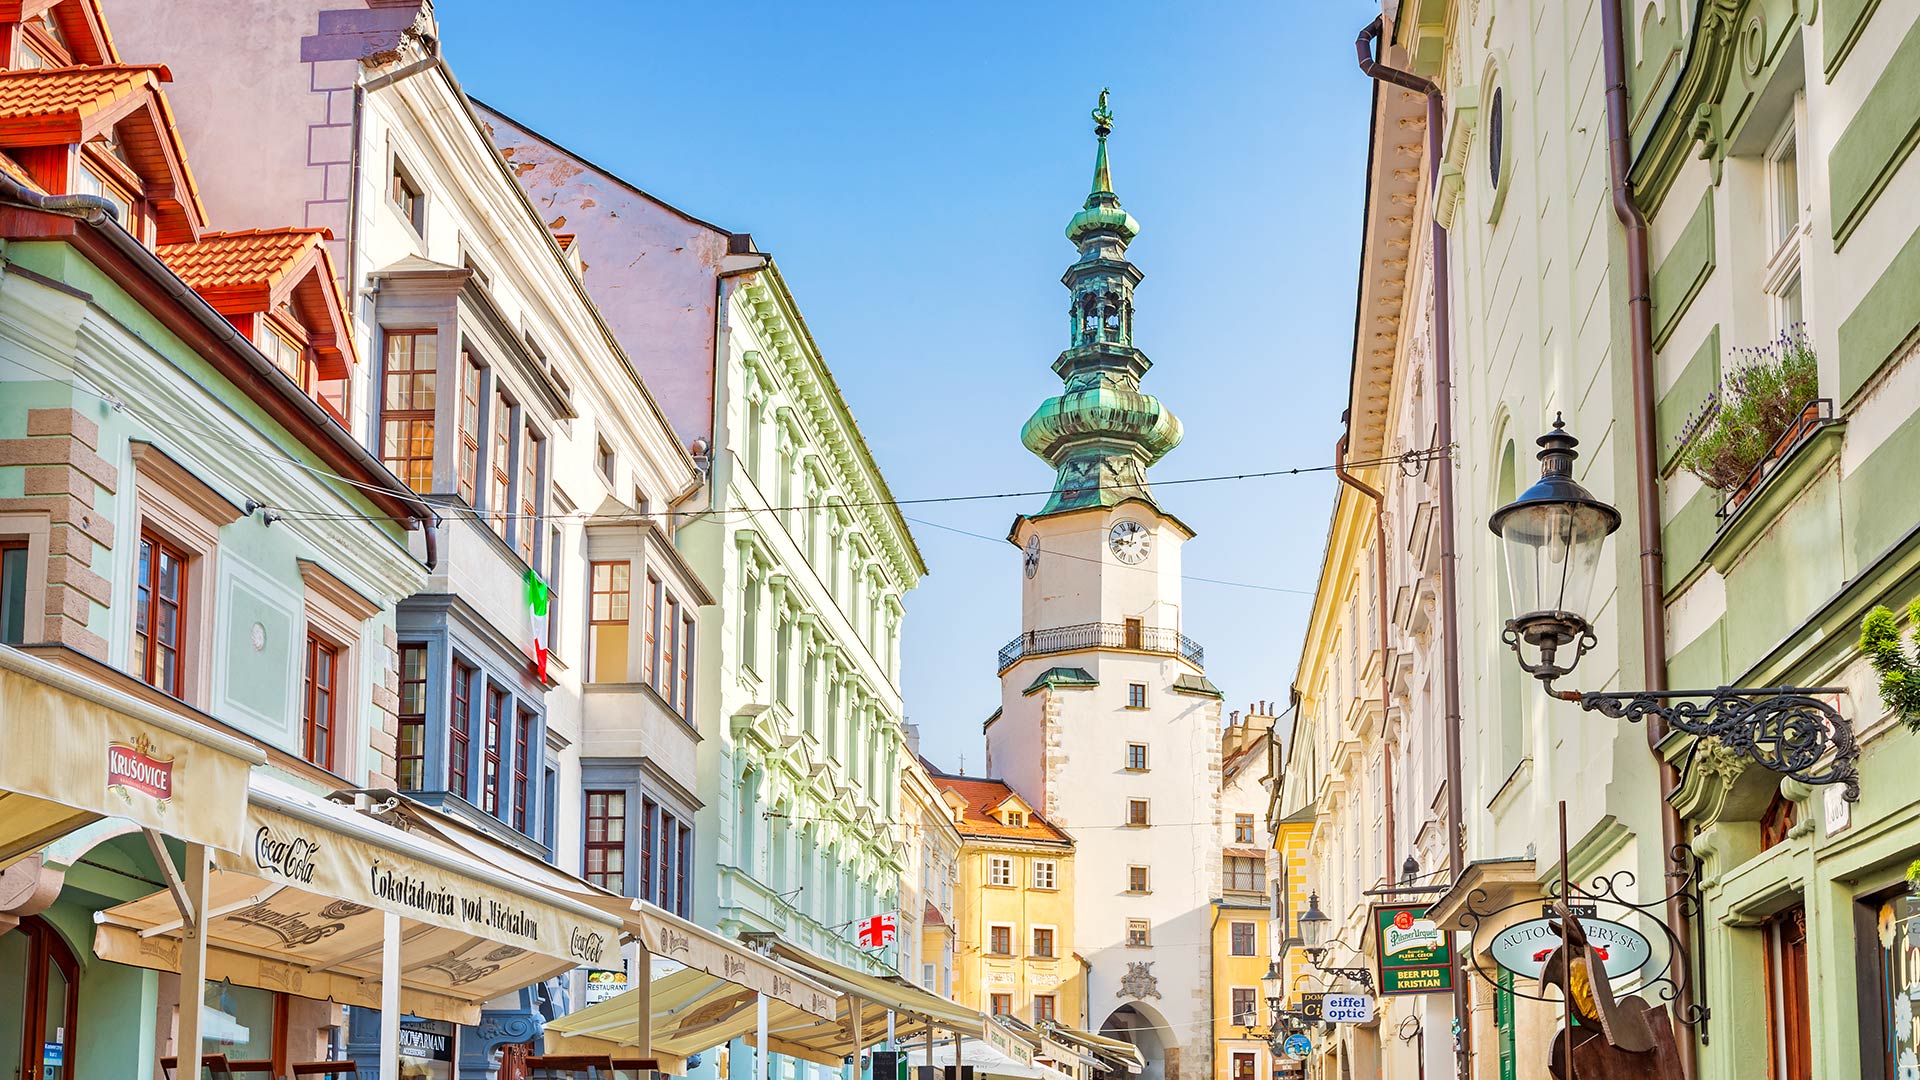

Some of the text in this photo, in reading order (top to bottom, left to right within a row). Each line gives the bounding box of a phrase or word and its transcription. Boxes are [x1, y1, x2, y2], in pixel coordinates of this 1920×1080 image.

[111, 750, 168, 791] KRUŠOVICE
[255, 826, 321, 884] Coca-Cola
[371, 859, 538, 941] Čokoládovňa pod Michalom
[1391, 928, 1438, 947] Pilsner Urquell
[1397, 970, 1439, 979] BEER PUB
[1397, 979, 1441, 988] KRISTIAN
[1330, 997, 1366, 1008] eiffel
[1329, 1008, 1365, 1020] optic
